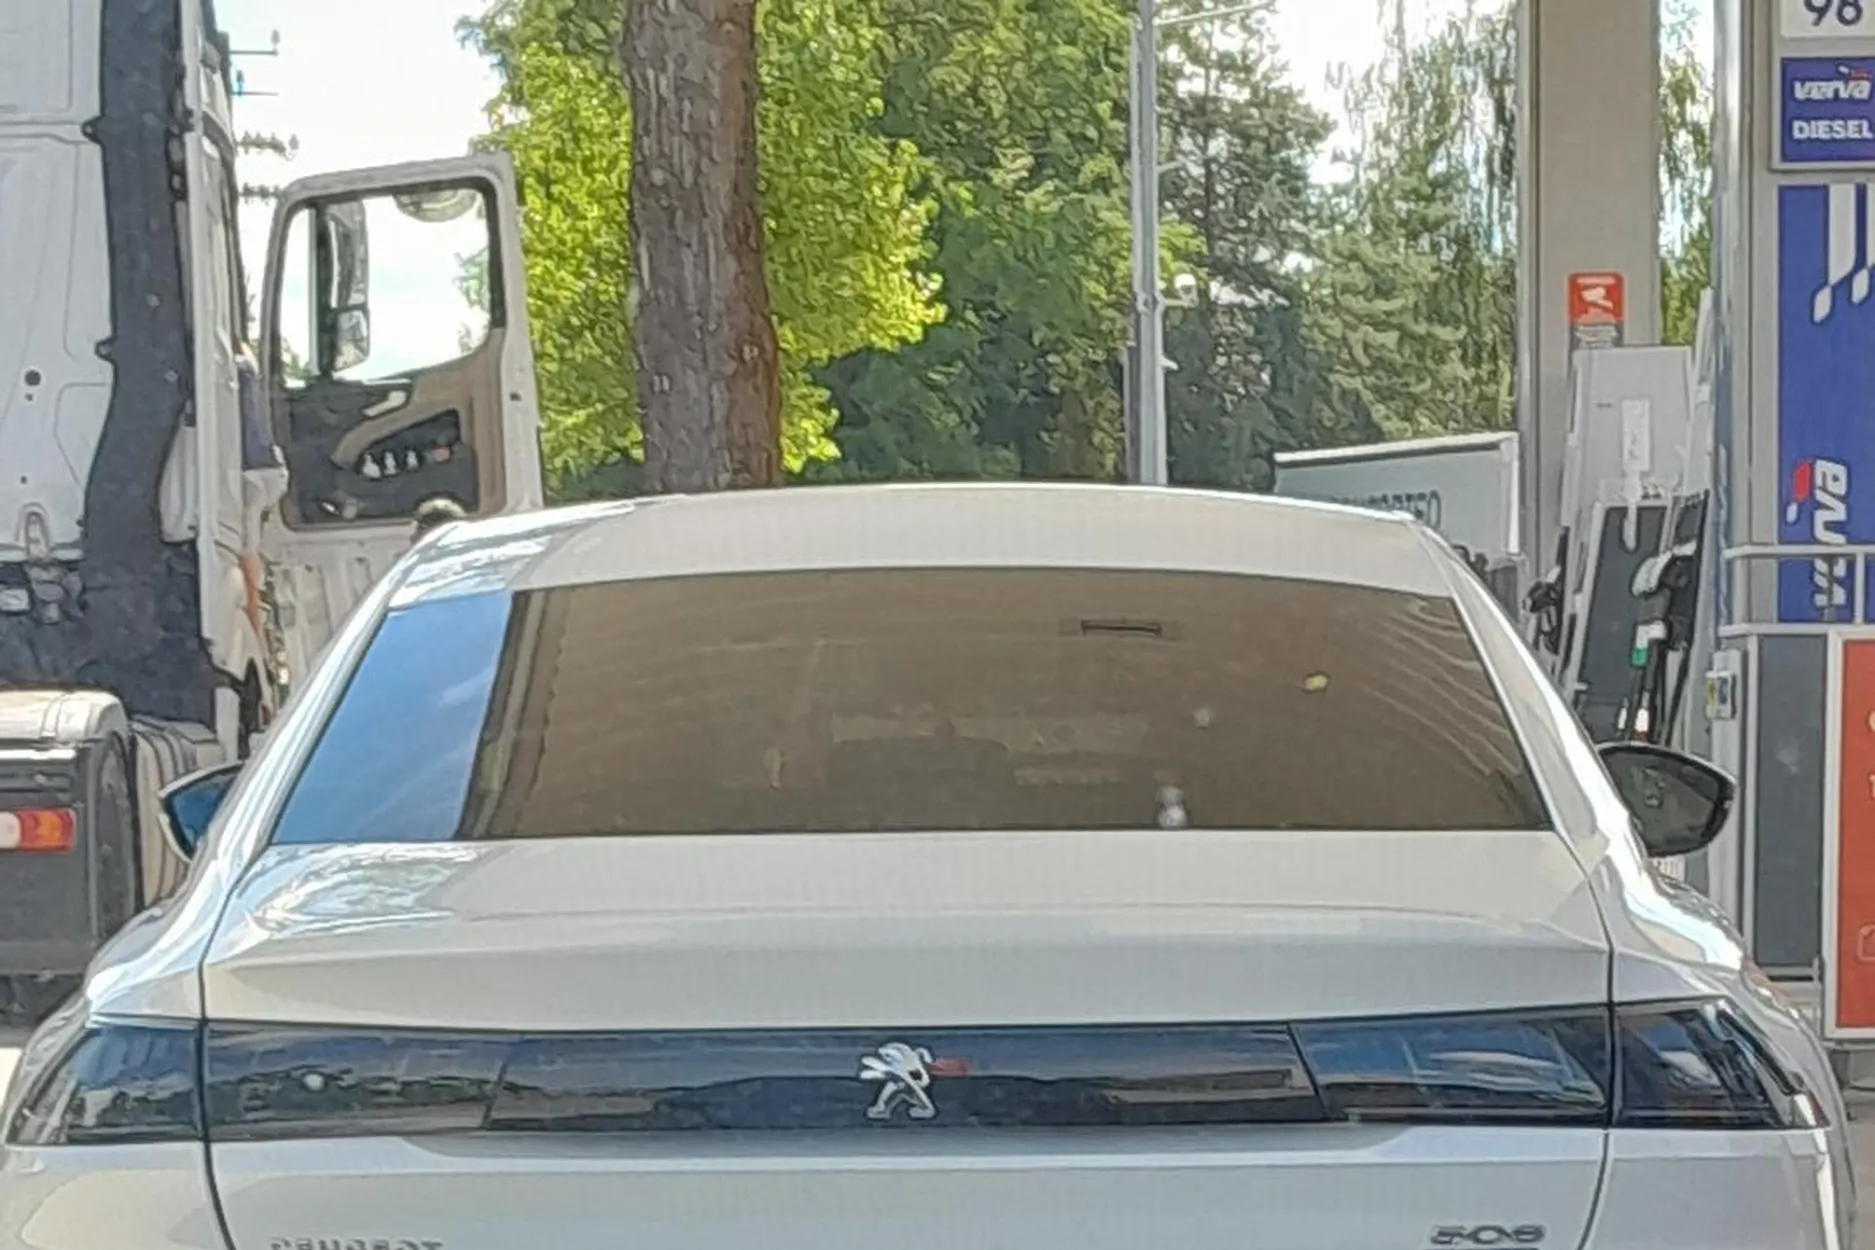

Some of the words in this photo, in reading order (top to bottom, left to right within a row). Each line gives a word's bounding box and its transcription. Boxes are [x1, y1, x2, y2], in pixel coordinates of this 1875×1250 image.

[1794, 80, 1871, 100] verva
[1792, 120, 1873, 139] DIESEL
[1430, 1224, 1546, 1245] 508
